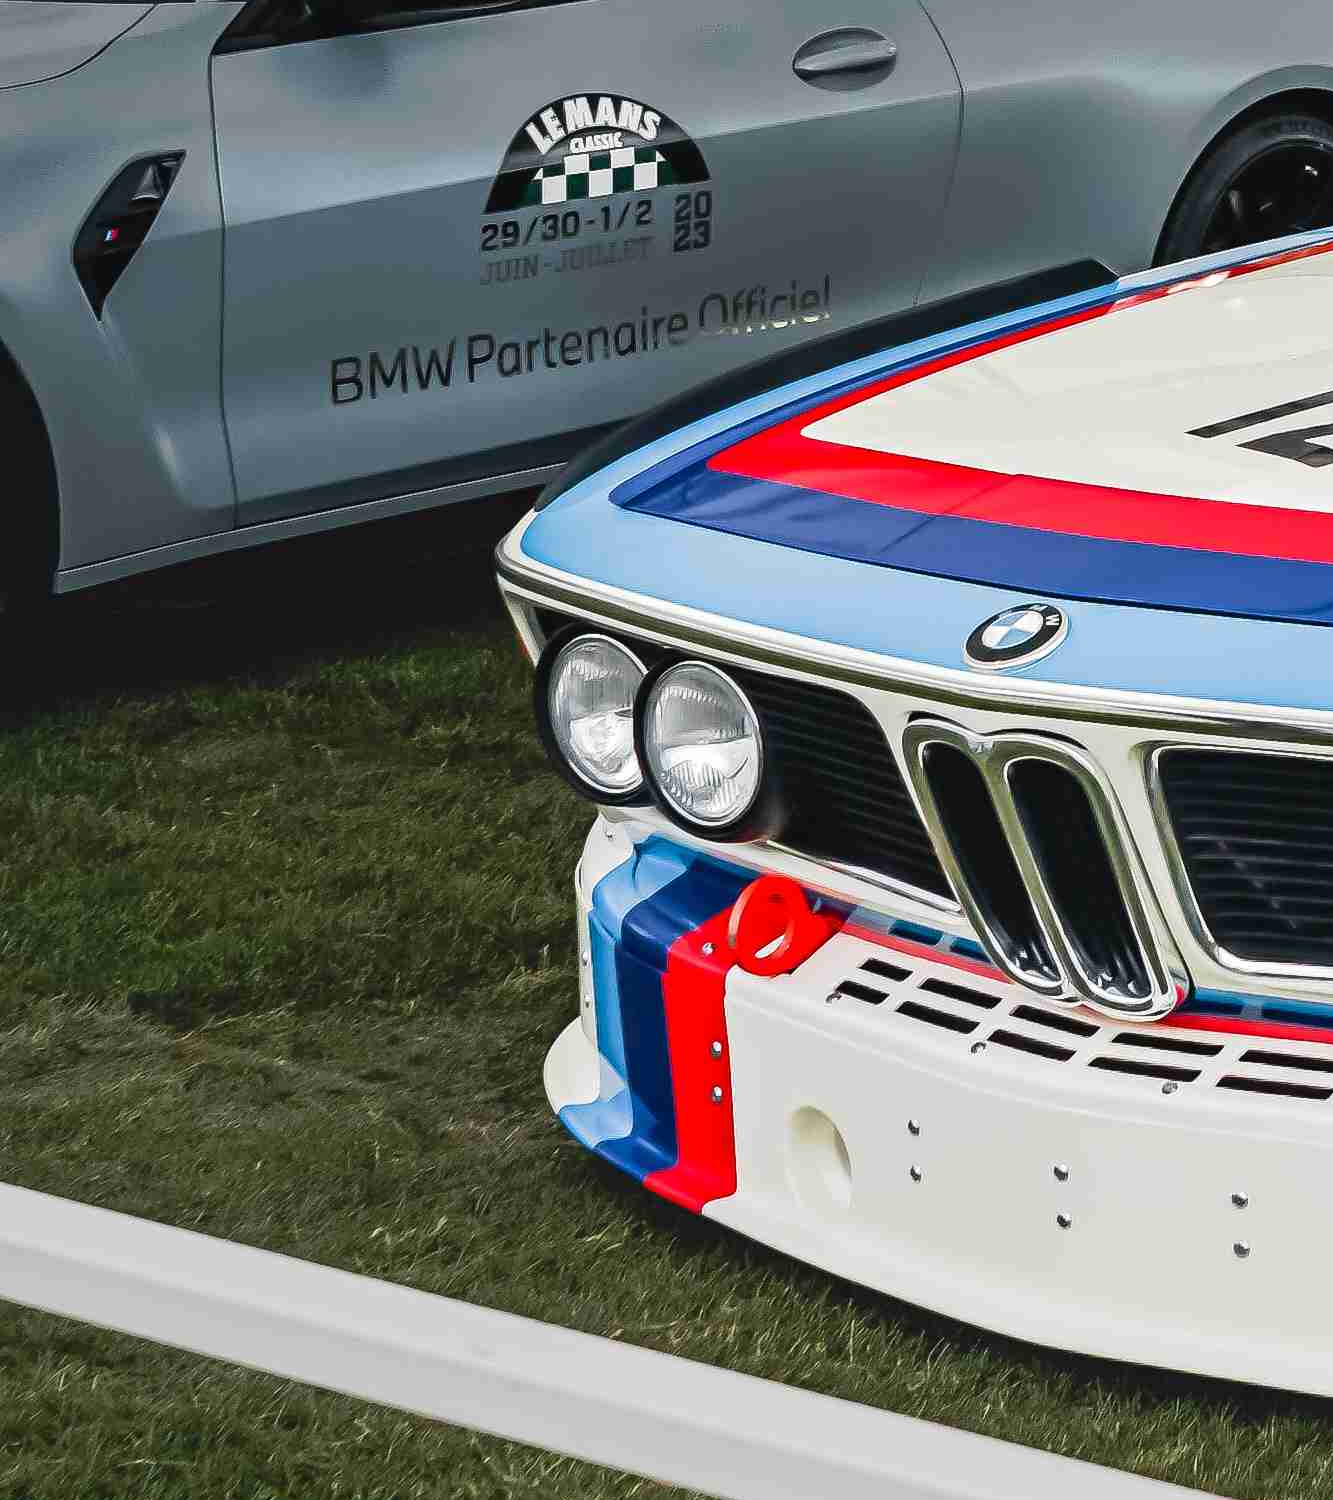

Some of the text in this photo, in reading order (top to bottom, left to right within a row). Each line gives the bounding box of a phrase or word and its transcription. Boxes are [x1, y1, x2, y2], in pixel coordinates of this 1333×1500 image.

[563, 96, 662, 142] MANS
[569, 131, 624, 154] CLASSIC
[330, 274, 832, 406] BMW Partenaire Officiel
